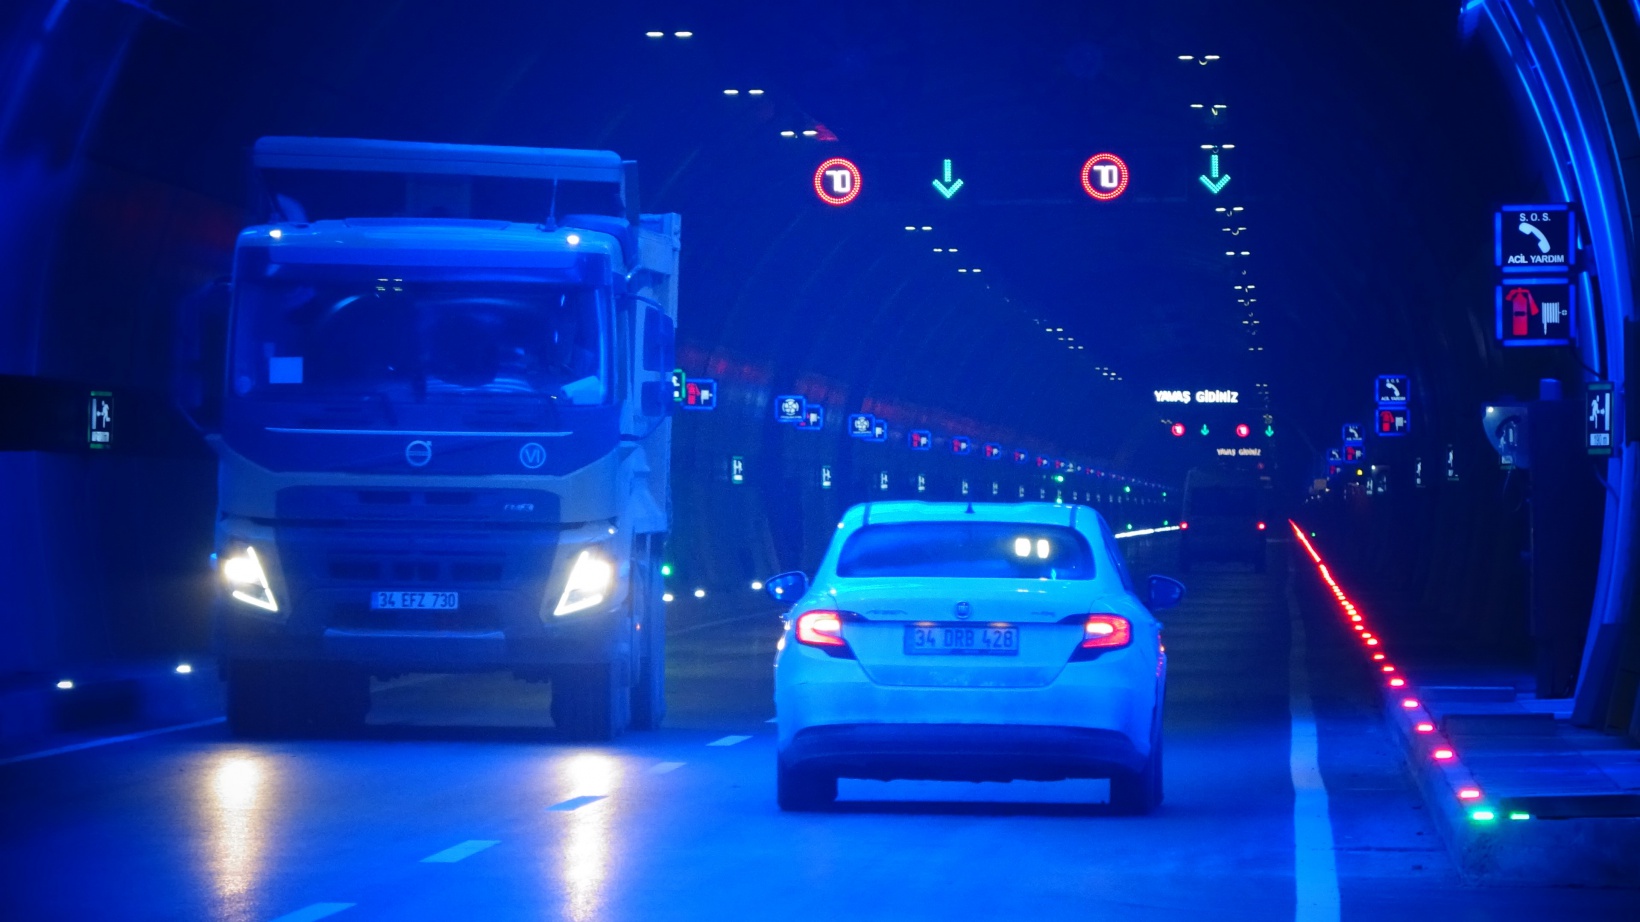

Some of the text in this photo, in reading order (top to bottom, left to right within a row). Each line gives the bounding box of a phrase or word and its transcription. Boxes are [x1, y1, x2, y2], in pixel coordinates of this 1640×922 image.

[825, 169, 851, 192] 70
[1092, 165, 1118, 188] 70
[1508, 253, 1564, 263] ACİL YARDIM
[1154, 390, 1238, 404] YAVAŞ GİDİNİZ
[379, 592, 456, 608] 34 EFZ 730
[915, 629, 936, 647] 34
[982, 630, 1014, 648] 428
